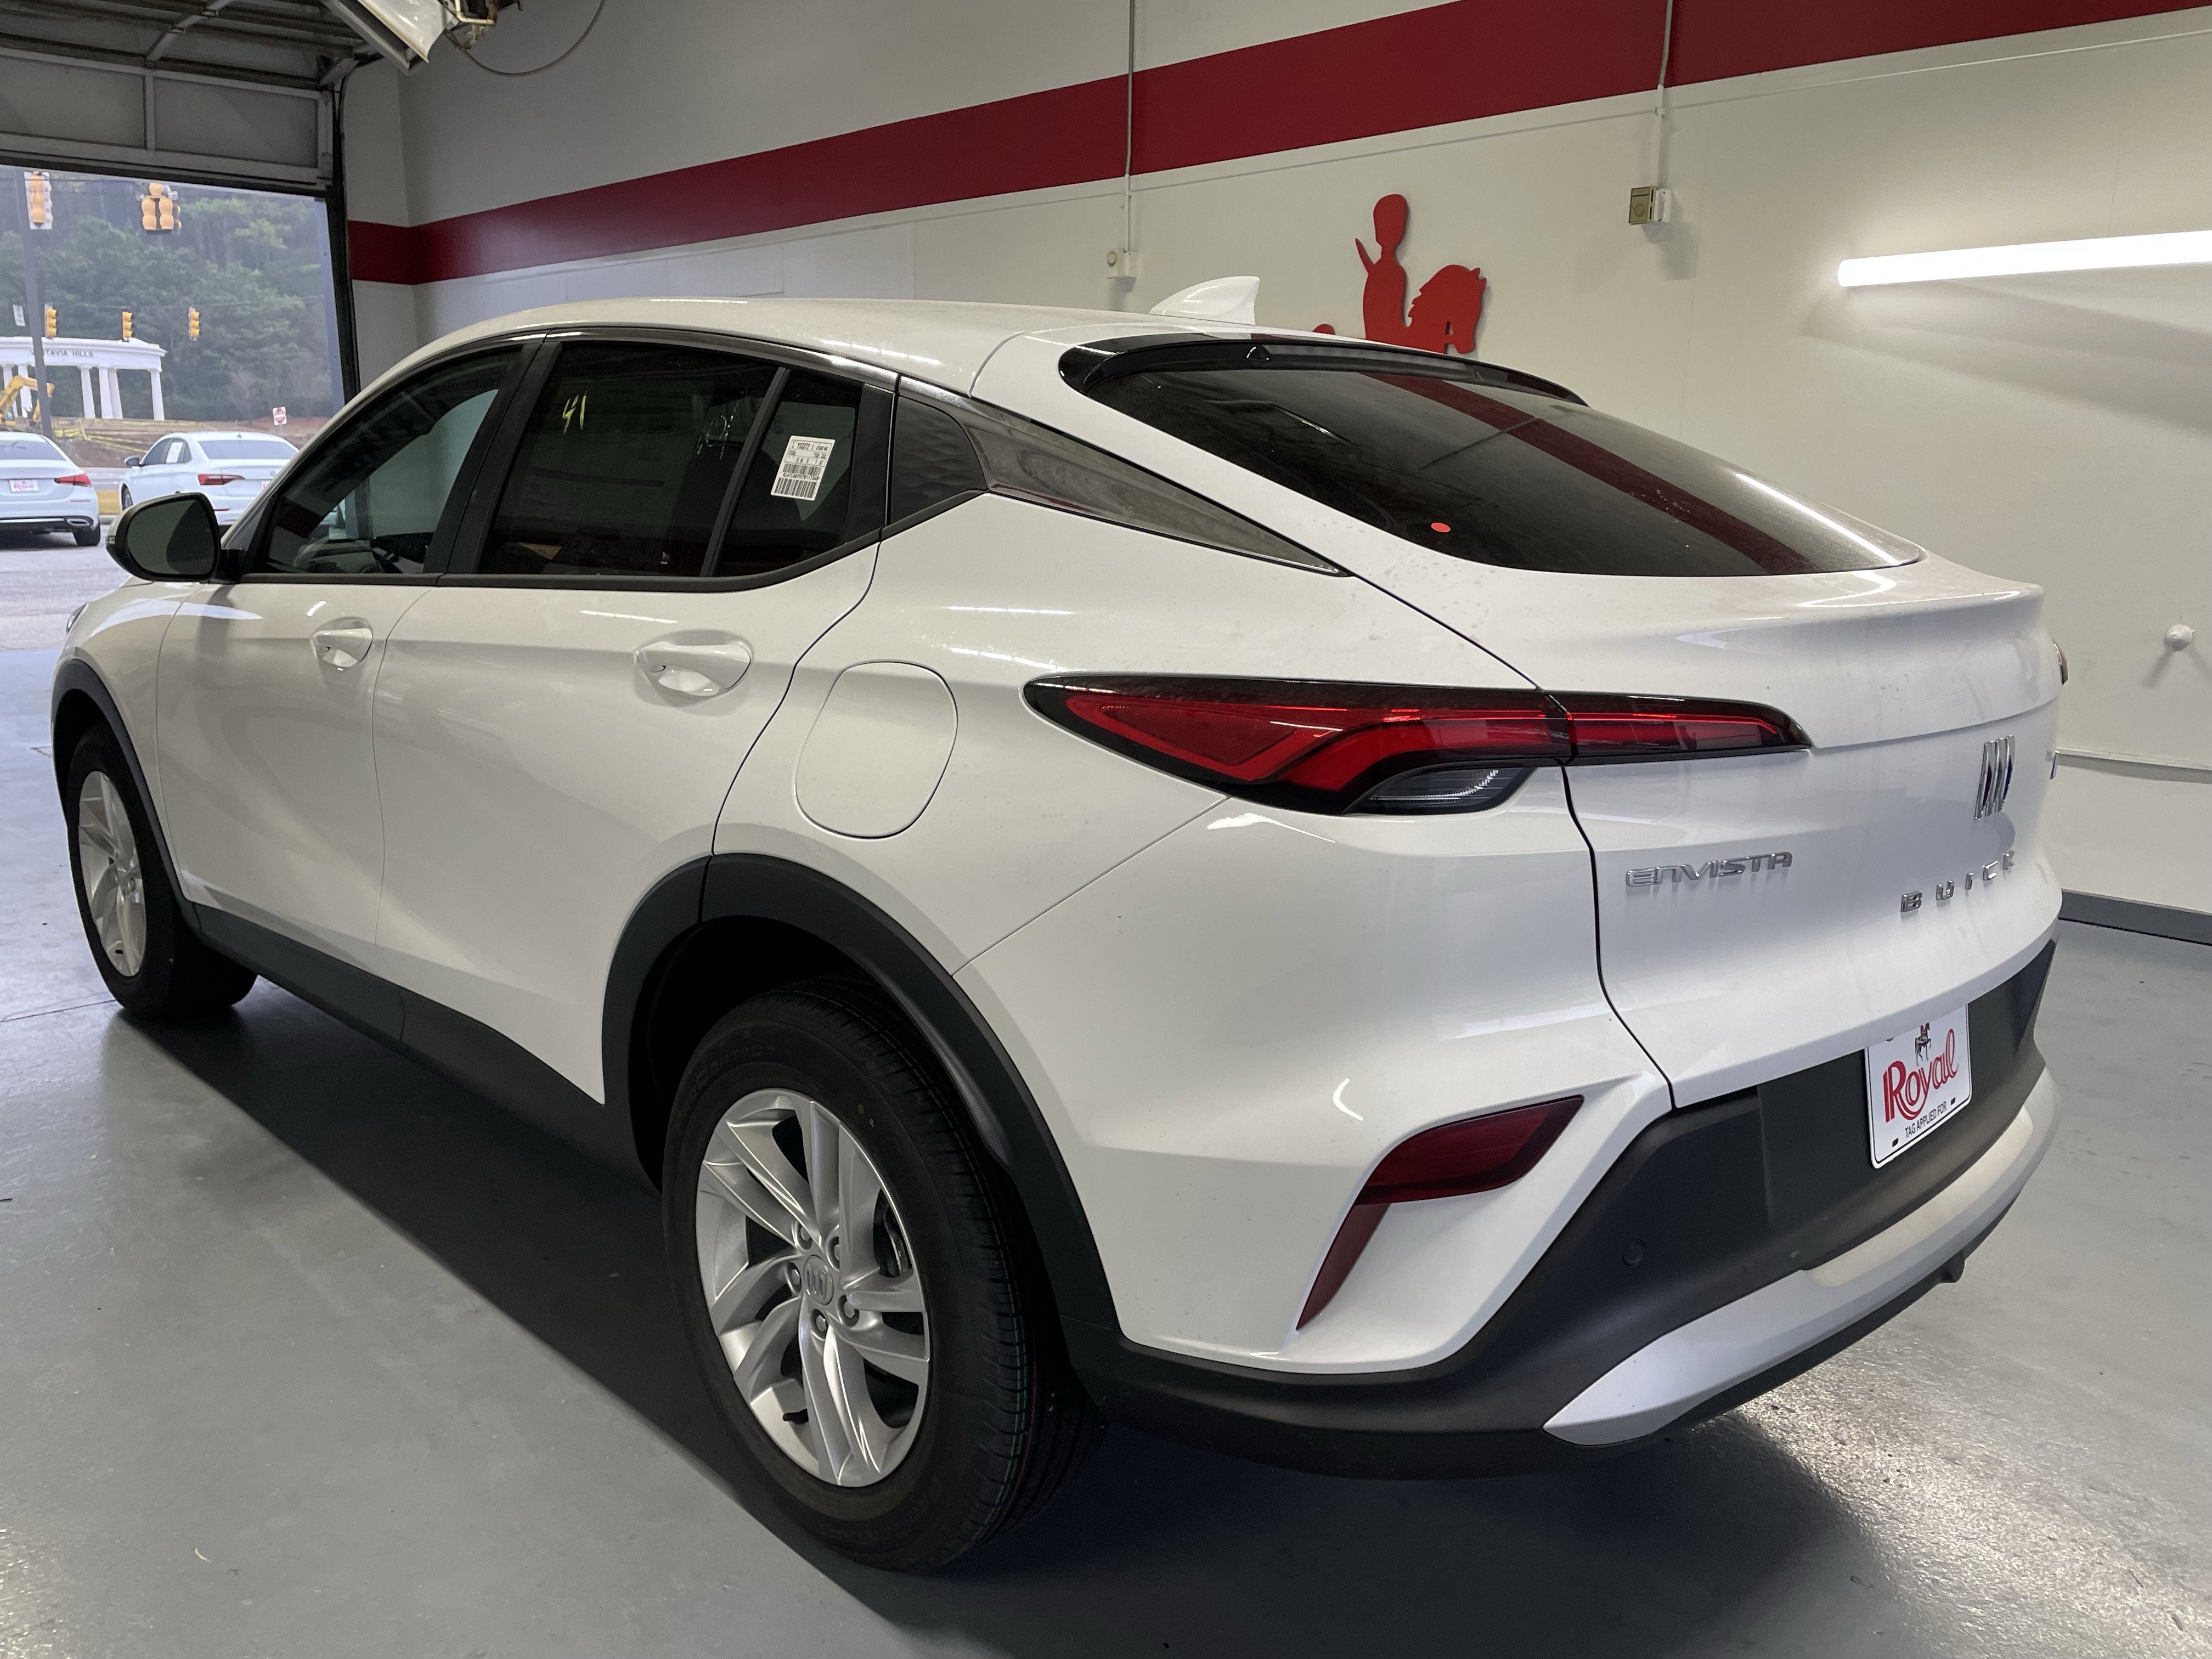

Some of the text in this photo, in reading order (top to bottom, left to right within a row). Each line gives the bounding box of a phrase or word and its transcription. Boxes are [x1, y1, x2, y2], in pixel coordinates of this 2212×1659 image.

[1626, 851, 1793, 887] ENVISTA
[1900, 849, 2015, 912] BUICK
[1883, 1028, 1959, 1123] Royal
[1905, 1101, 1947, 1138] TAG APPLIED FOR
